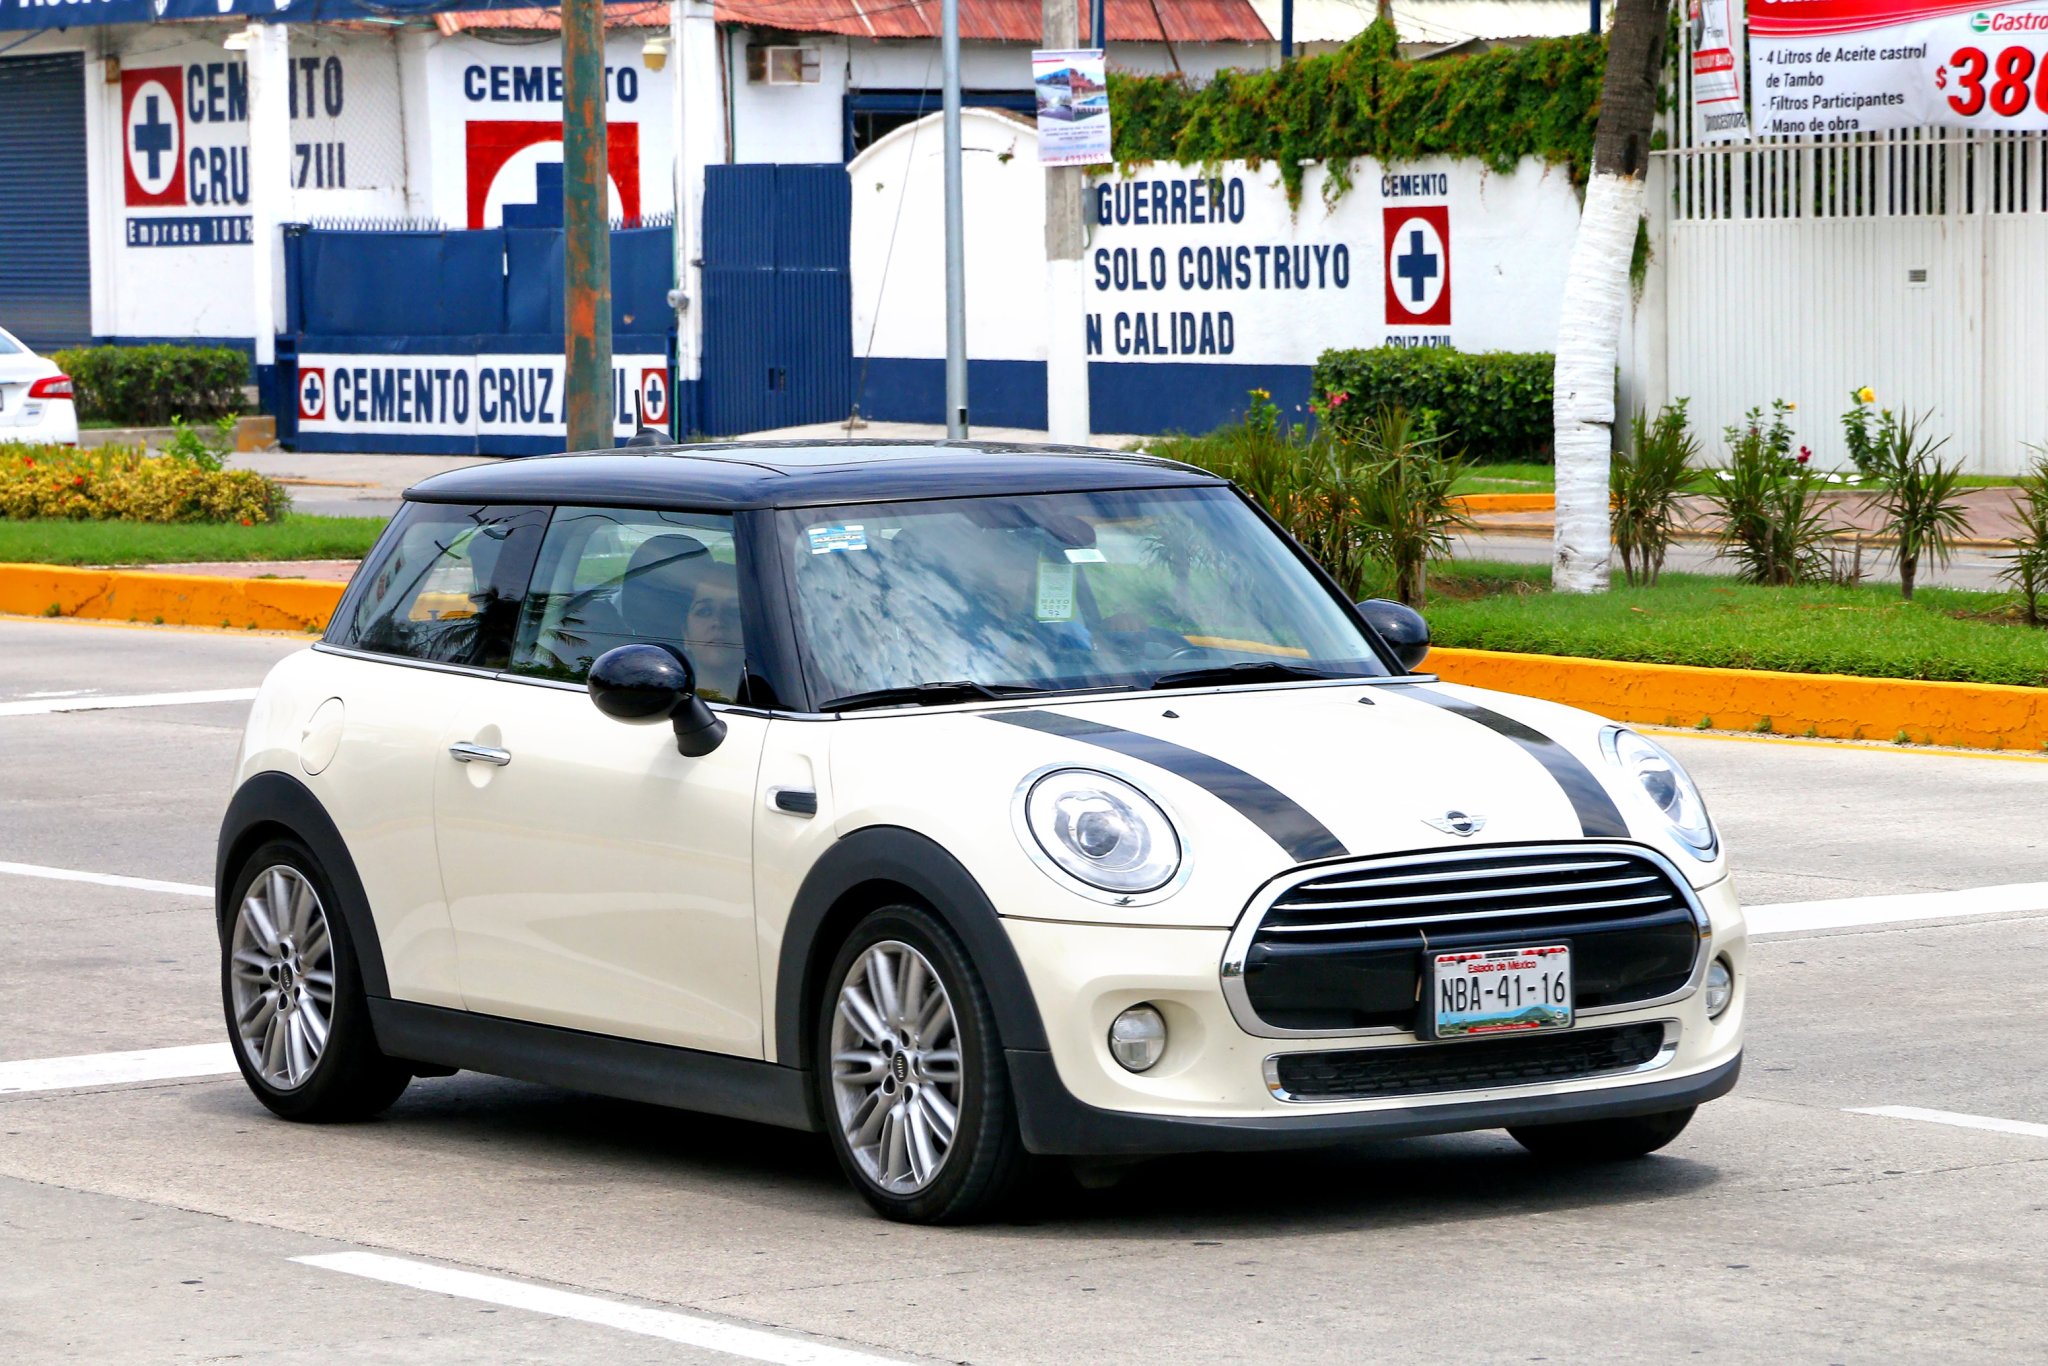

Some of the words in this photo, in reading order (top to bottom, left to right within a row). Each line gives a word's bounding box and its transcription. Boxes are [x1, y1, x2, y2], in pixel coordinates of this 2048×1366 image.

[1766, 52, 1774, 65] 4
[1777, 49, 1812, 64] Litros
[1816, 48, 1831, 62] de
[1835, 45, 1876, 61] Aceite
[1880, 43, 1927, 60] castrol
[187, 56, 343, 124] CEMTO
[1766, 73, 1780, 88] de
[1784, 72, 1824, 88] Tambo
[1769, 95, 1808, 111] Filtros
[1812, 92, 1904, 112] Participantes
[1772, 119, 1805, 134] Mano
[1809, 117, 1823, 132] de
[1828, 116, 1859, 131] obra
[189, 146, 249, 206] CRU
[1382, 172, 1447, 197] CEMENTO
[1098, 177, 1245, 226] GUERRERO
[128, 219, 201, 246] Empresa
[1095, 247, 1166, 291] SOLO
[1178, 243, 1350, 290] CONSTRUYO
[1114, 311, 1235, 355] CALIDAD
[333, 368, 469, 424] CEMENTO
[479, 368, 554, 424] CRUZ
[1468, 963, 1494, 973] Estado
[1497, 962, 1505, 971] de
[1441, 971, 1565, 1013] NBA-41-16
